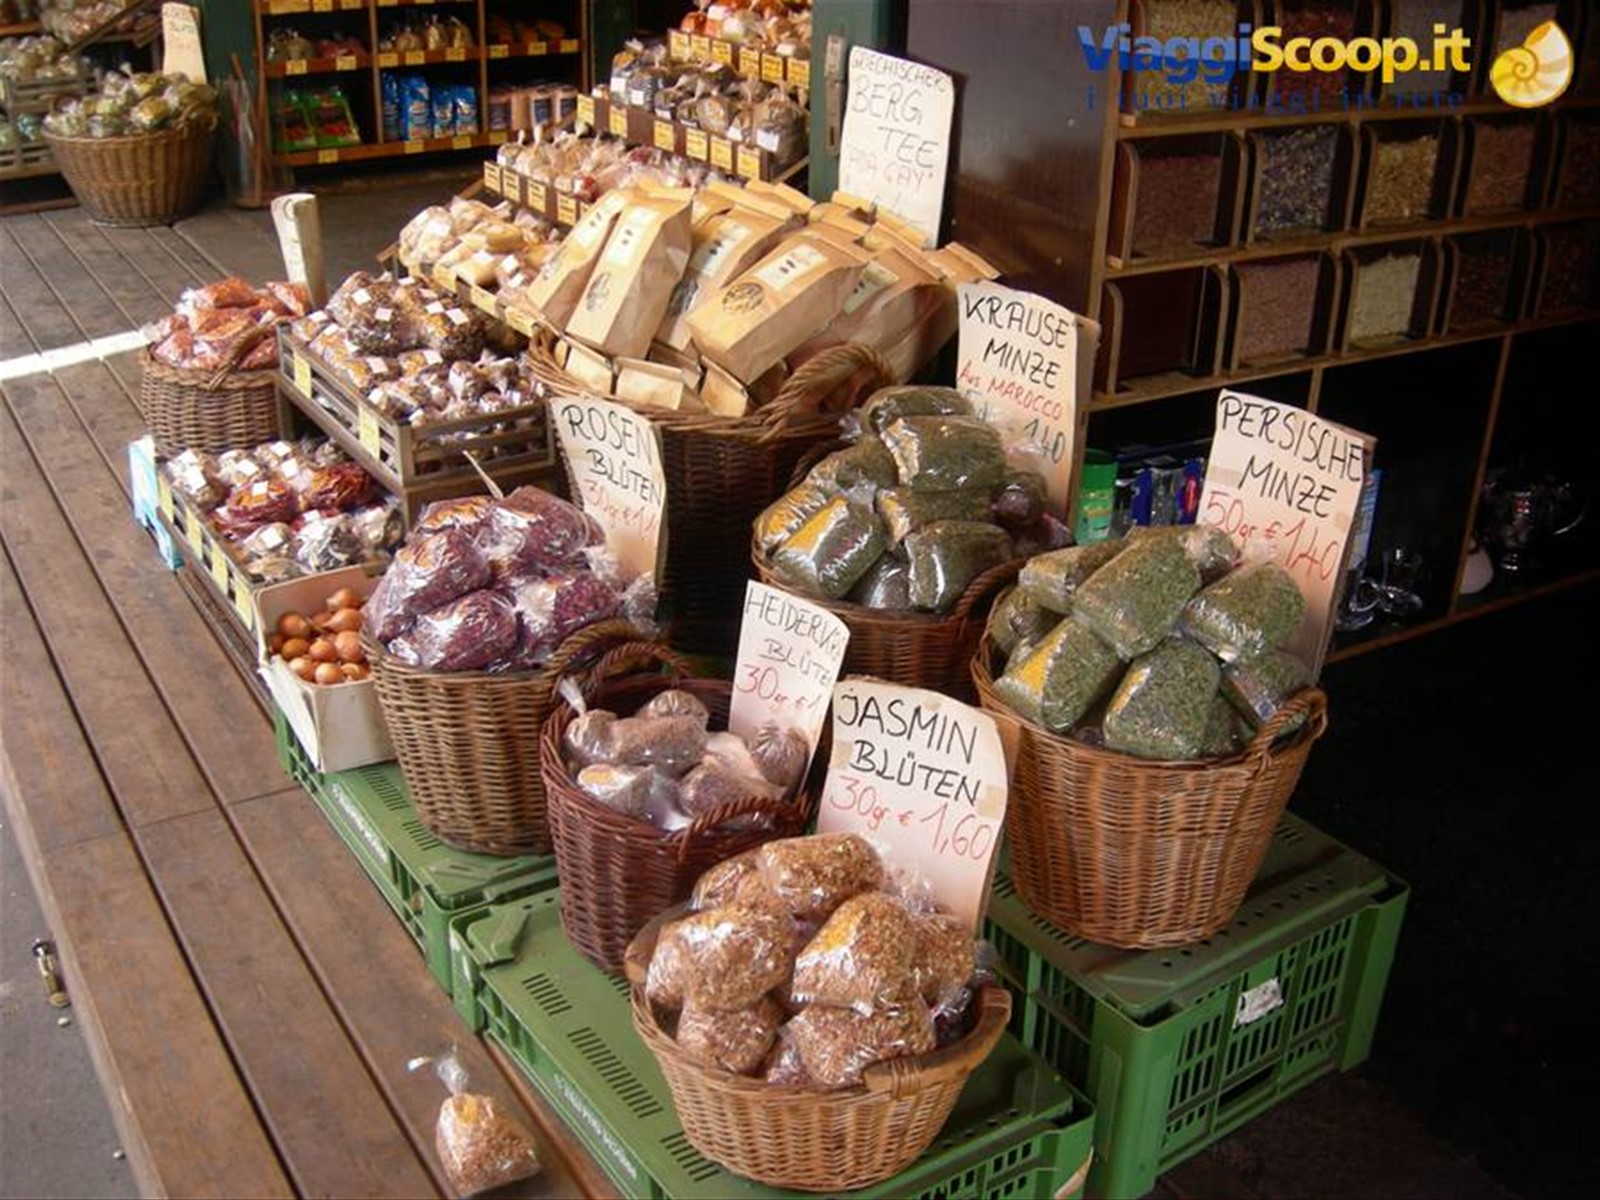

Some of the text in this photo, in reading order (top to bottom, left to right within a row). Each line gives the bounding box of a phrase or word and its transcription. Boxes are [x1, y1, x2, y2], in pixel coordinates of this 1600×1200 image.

[851, 75, 923, 125] BERG
[878, 125, 940, 169] TEE
[964, 292, 1069, 349] KRAUSE
[983, 337, 1060, 389] MINZE
[987, 378, 1064, 421] MAROCCO
[561, 404, 652, 465] ROSEN
[1220, 395, 1363, 482] PERSISCHE
[586, 448, 661, 508] BLÜTEN
[1238, 454, 1337, 518] MINZE
[1206, 490, 1256, 551] 50gr
[837, 688, 978, 765] JASMIN
[849, 739, 982, 807] BLÜTEN
[829, 775, 890, 831] 30gr
[919, 803, 993, 860] 1,60
